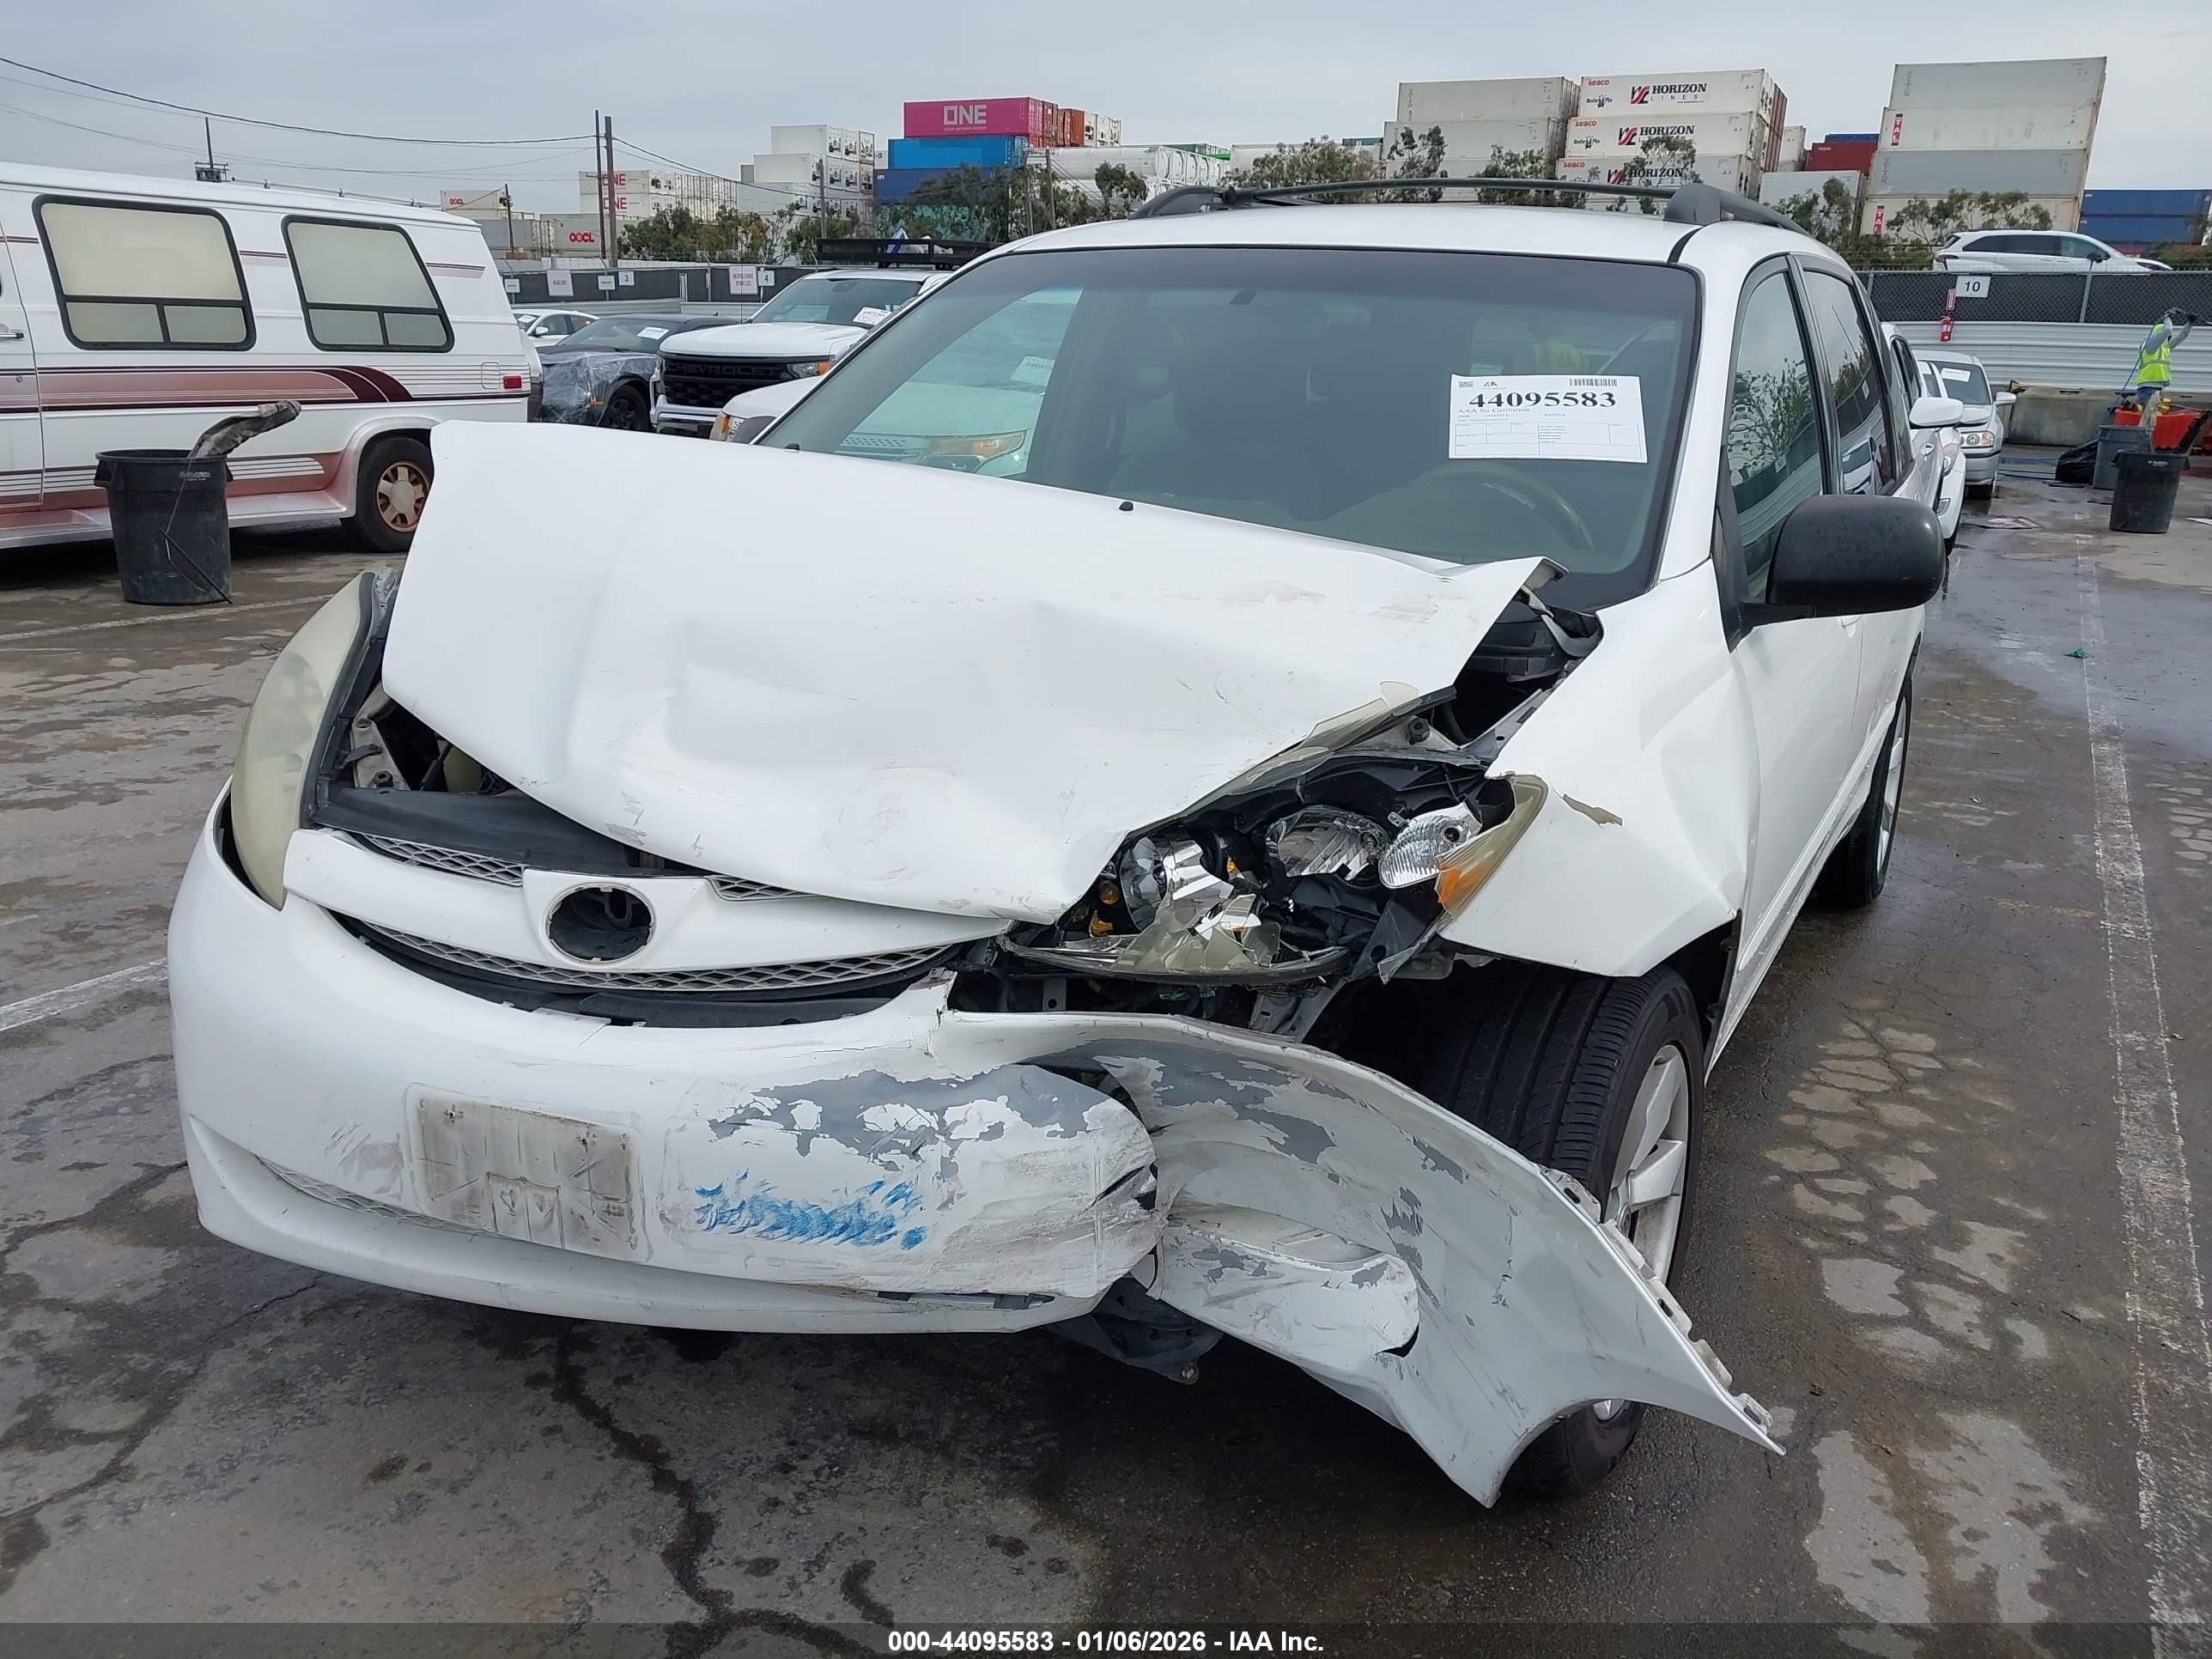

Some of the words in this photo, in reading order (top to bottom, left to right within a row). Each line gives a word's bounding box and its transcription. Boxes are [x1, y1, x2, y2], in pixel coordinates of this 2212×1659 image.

[1651, 83, 1708, 94] HORIZON
[944, 105, 987, 125] ONE
[1639, 125, 1695, 136] HORIZON
[1892, 118, 1903, 141] TAL
[1630, 167, 1683, 178] HORIZON
[569, 232, 595, 243] OOCL
[624, 274, 629, 283] 3
[763, 274, 769, 283] 4
[1964, 281, 1981, 293] 10
[1469, 392, 1616, 408] 44095583
